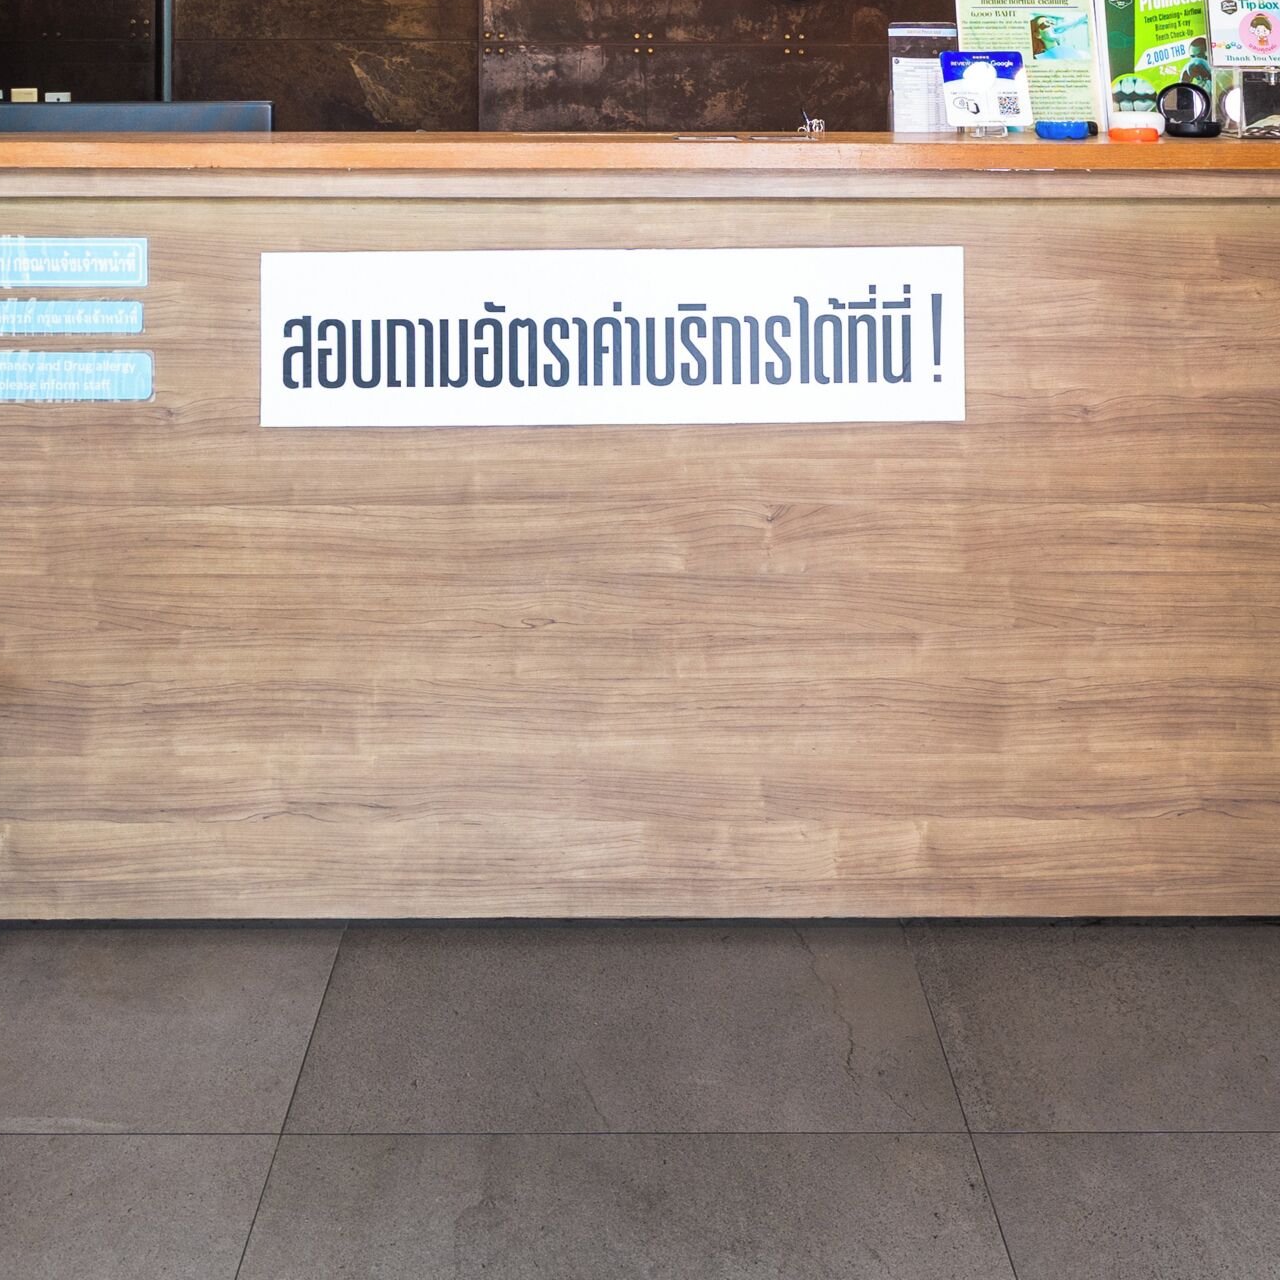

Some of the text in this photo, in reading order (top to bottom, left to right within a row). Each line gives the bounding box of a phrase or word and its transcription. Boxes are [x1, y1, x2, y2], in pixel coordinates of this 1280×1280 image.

[1238, 0, 1280, 11] Tip Box
[1146, 44, 1186, 65] 2,000 THB
[990, 59, 1014, 68] Google
[282, 283, 945, 389] สอบถามอัตราค่าบริการได้ที่นี่ !
[38, 360, 61, 371] and
[63, 360, 93, 374] Drug
[95, 360, 136, 374] allergy
[39, 380, 80, 391] inform
[83, 380, 111, 391] staff
